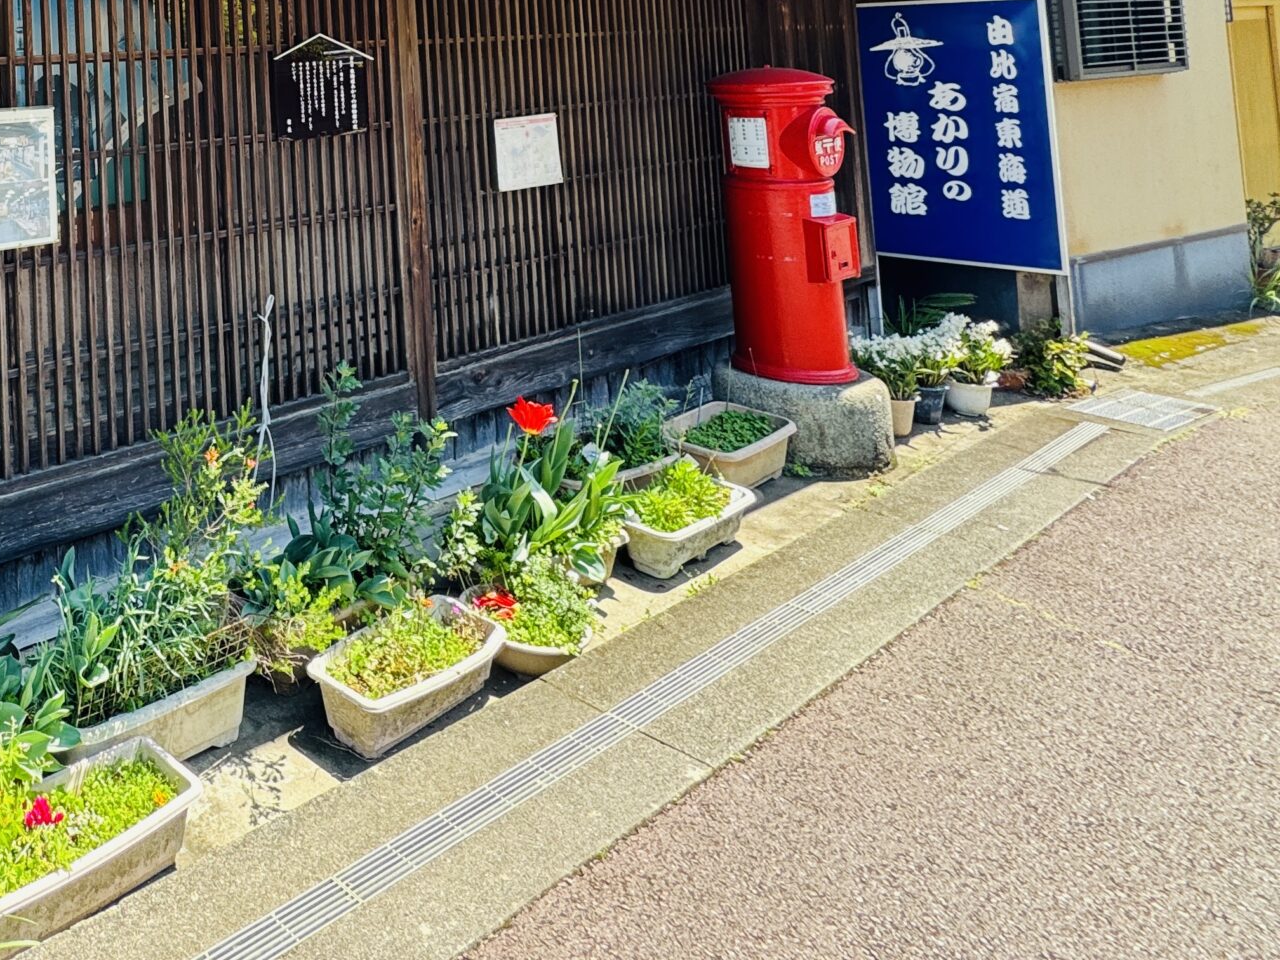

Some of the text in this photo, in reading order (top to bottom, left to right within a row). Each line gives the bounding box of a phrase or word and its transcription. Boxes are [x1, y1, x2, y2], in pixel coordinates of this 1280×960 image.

[819, 153, 839, 167] POST
[884, 111, 928, 216] 博物館
[927, 81, 972, 202] あかりの
[986, 15, 1031, 220] 由比宿東海道
